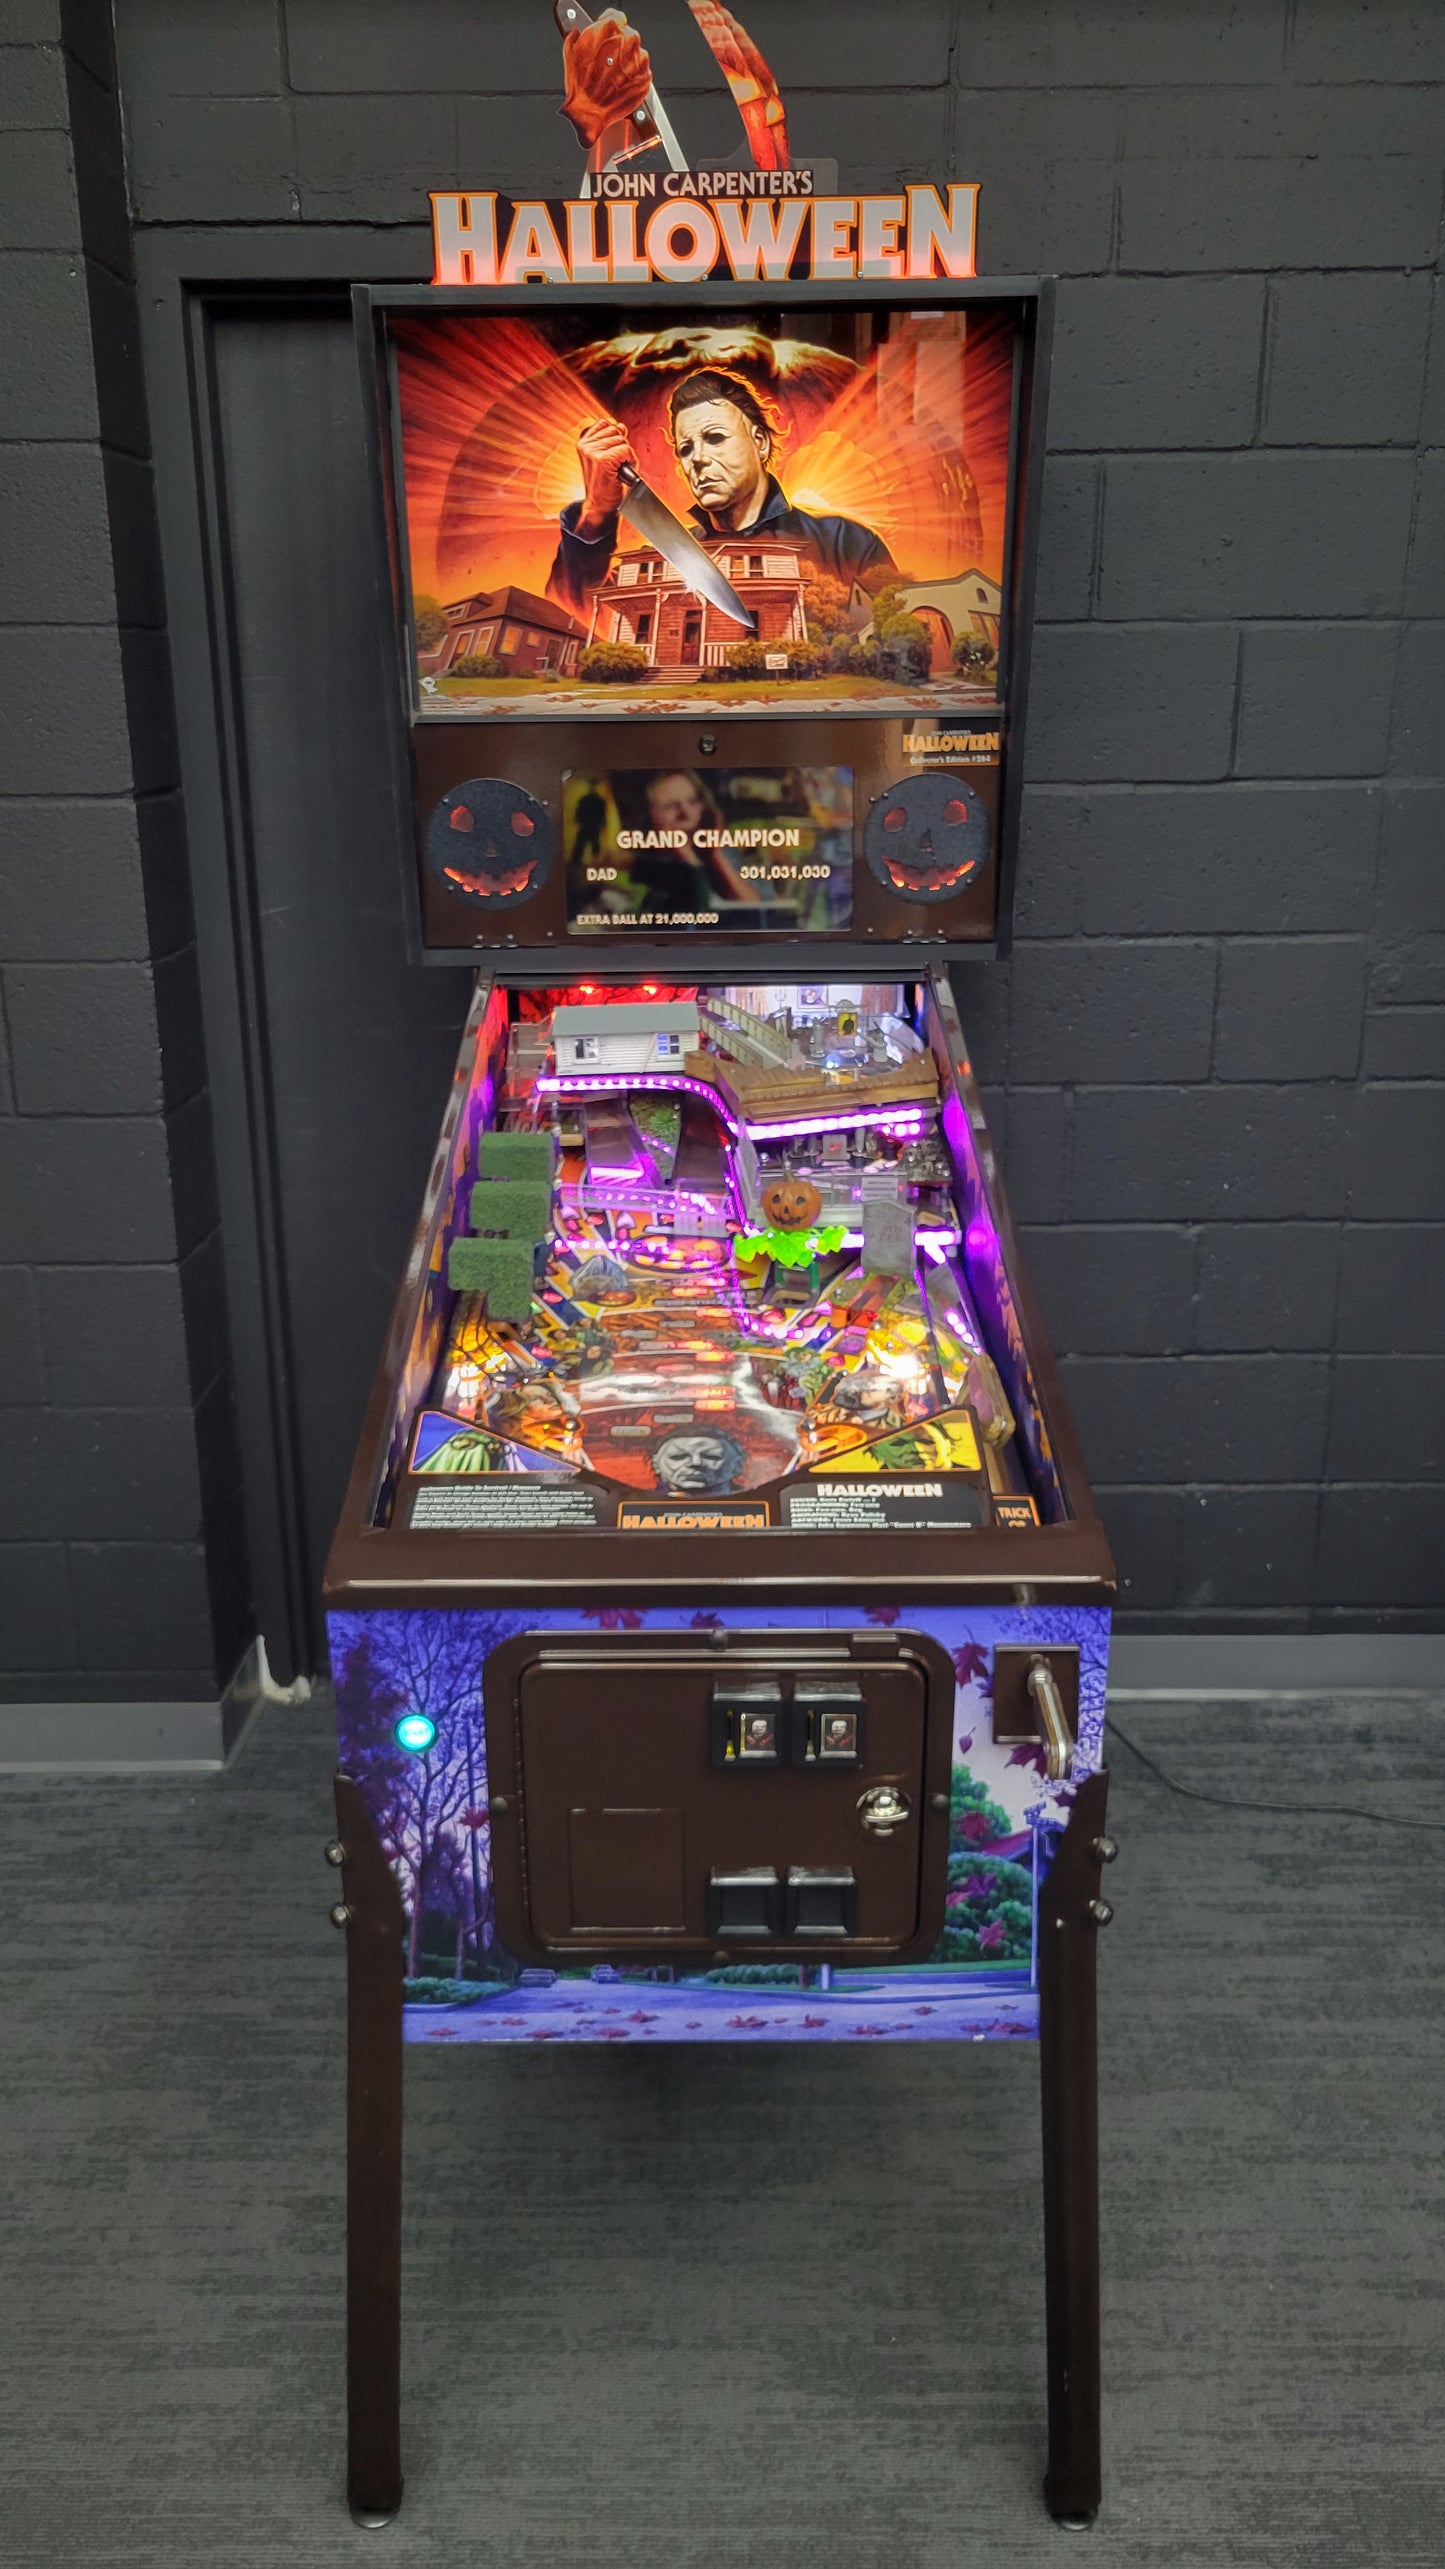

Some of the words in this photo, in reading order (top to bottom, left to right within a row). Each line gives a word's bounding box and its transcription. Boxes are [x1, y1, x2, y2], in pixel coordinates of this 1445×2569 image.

[593, 172, 656, 198] JOHN
[662, 170, 813, 196] CARPENTER'S
[429, 184, 981, 286] HALLOWEEN
[902, 732, 1000, 752] HALLOWEEN
[616, 830, 688, 849] GRAND
[692, 828, 800, 848] CHAMPION
[586, 867, 618, 881] DAD
[740, 865, 831, 880] 301,031,030
[576, 914, 611, 925] EXTRA
[612, 914, 638, 924] BALL
[639, 913, 654, 924] AT
[655, 912, 719, 925] 21,000,000
[816, 1483, 943, 1497] HALLOWEEN
[997, 1506, 1032, 1519] TRICK
[622, 1514, 764, 1528] HALLOWEEN
